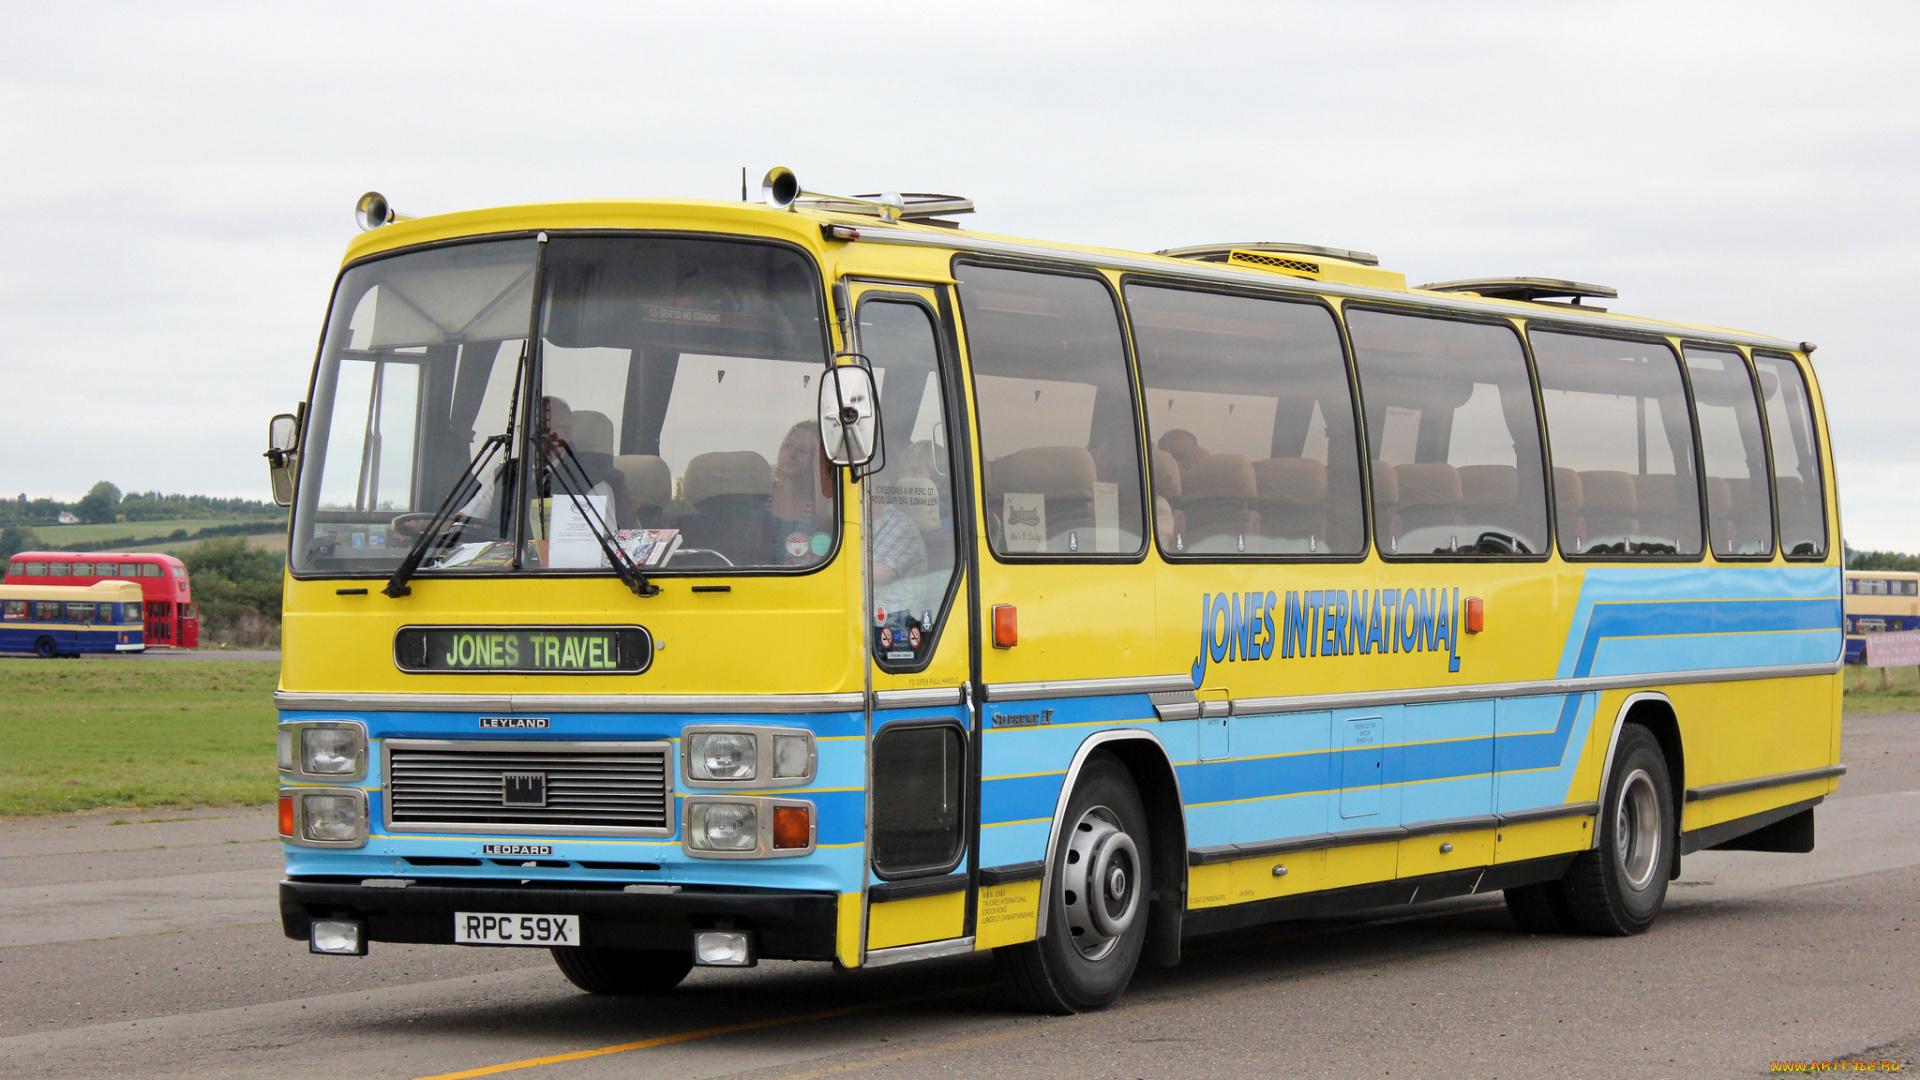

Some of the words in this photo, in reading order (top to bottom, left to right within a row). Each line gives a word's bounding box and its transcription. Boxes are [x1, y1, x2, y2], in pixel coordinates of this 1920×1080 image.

[659, 309, 681, 319] SEATED
[682, 311, 692, 320] NO
[693, 312, 720, 322] STANDING
[1191, 590, 1278, 691] JONES
[1281, 587, 1461, 673] INTERNATIONAL
[446, 633, 520, 667] JONES
[530, 635, 617, 668] TRAVEL
[909, 678, 916, 686] TO
[916, 678, 929, 686] OPEN
[930, 677, 941, 685] PULL
[941, 676, 959, 684] HANDLE
[482, 718, 546, 728] LEYLAND
[1041, 708, 1055, 725] IV
[485, 845, 549, 854] LEOPARD
[466, 915, 513, 940] RPC
[519, 917, 568, 942] 59X
